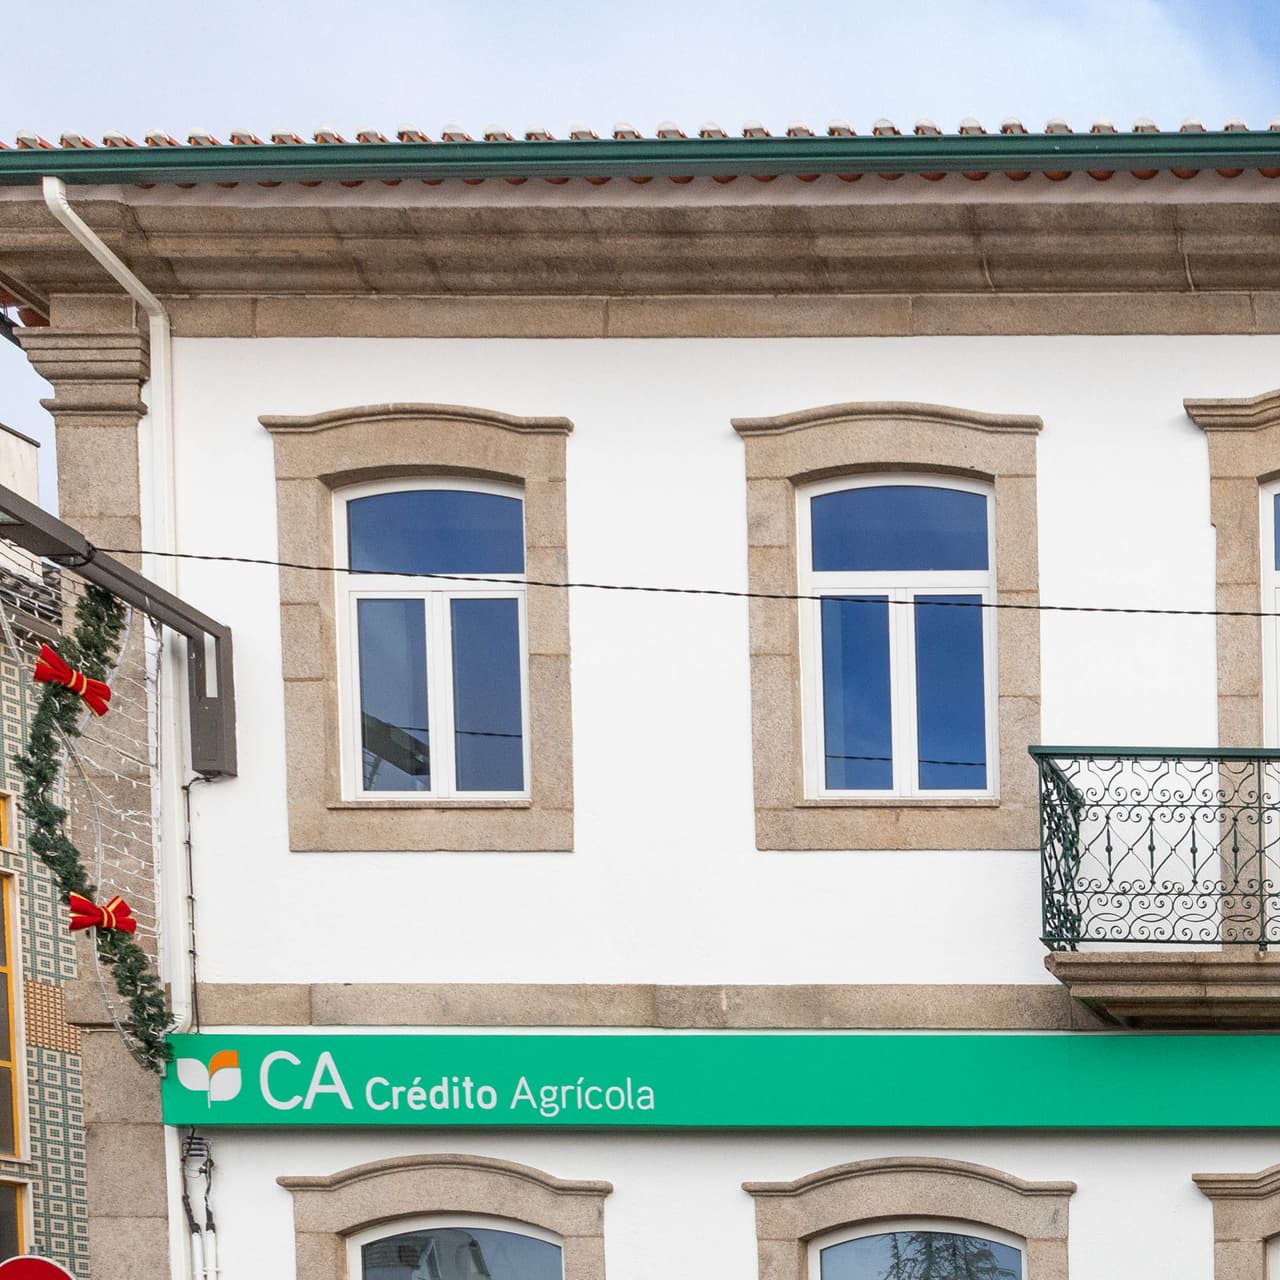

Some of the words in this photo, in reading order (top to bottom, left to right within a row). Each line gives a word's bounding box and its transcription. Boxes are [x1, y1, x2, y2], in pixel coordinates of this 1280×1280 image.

[259, 1050, 353, 1110] CA
[365, 1076, 497, 1110] Crédito
[510, 1076, 655, 1118] Agrícola
